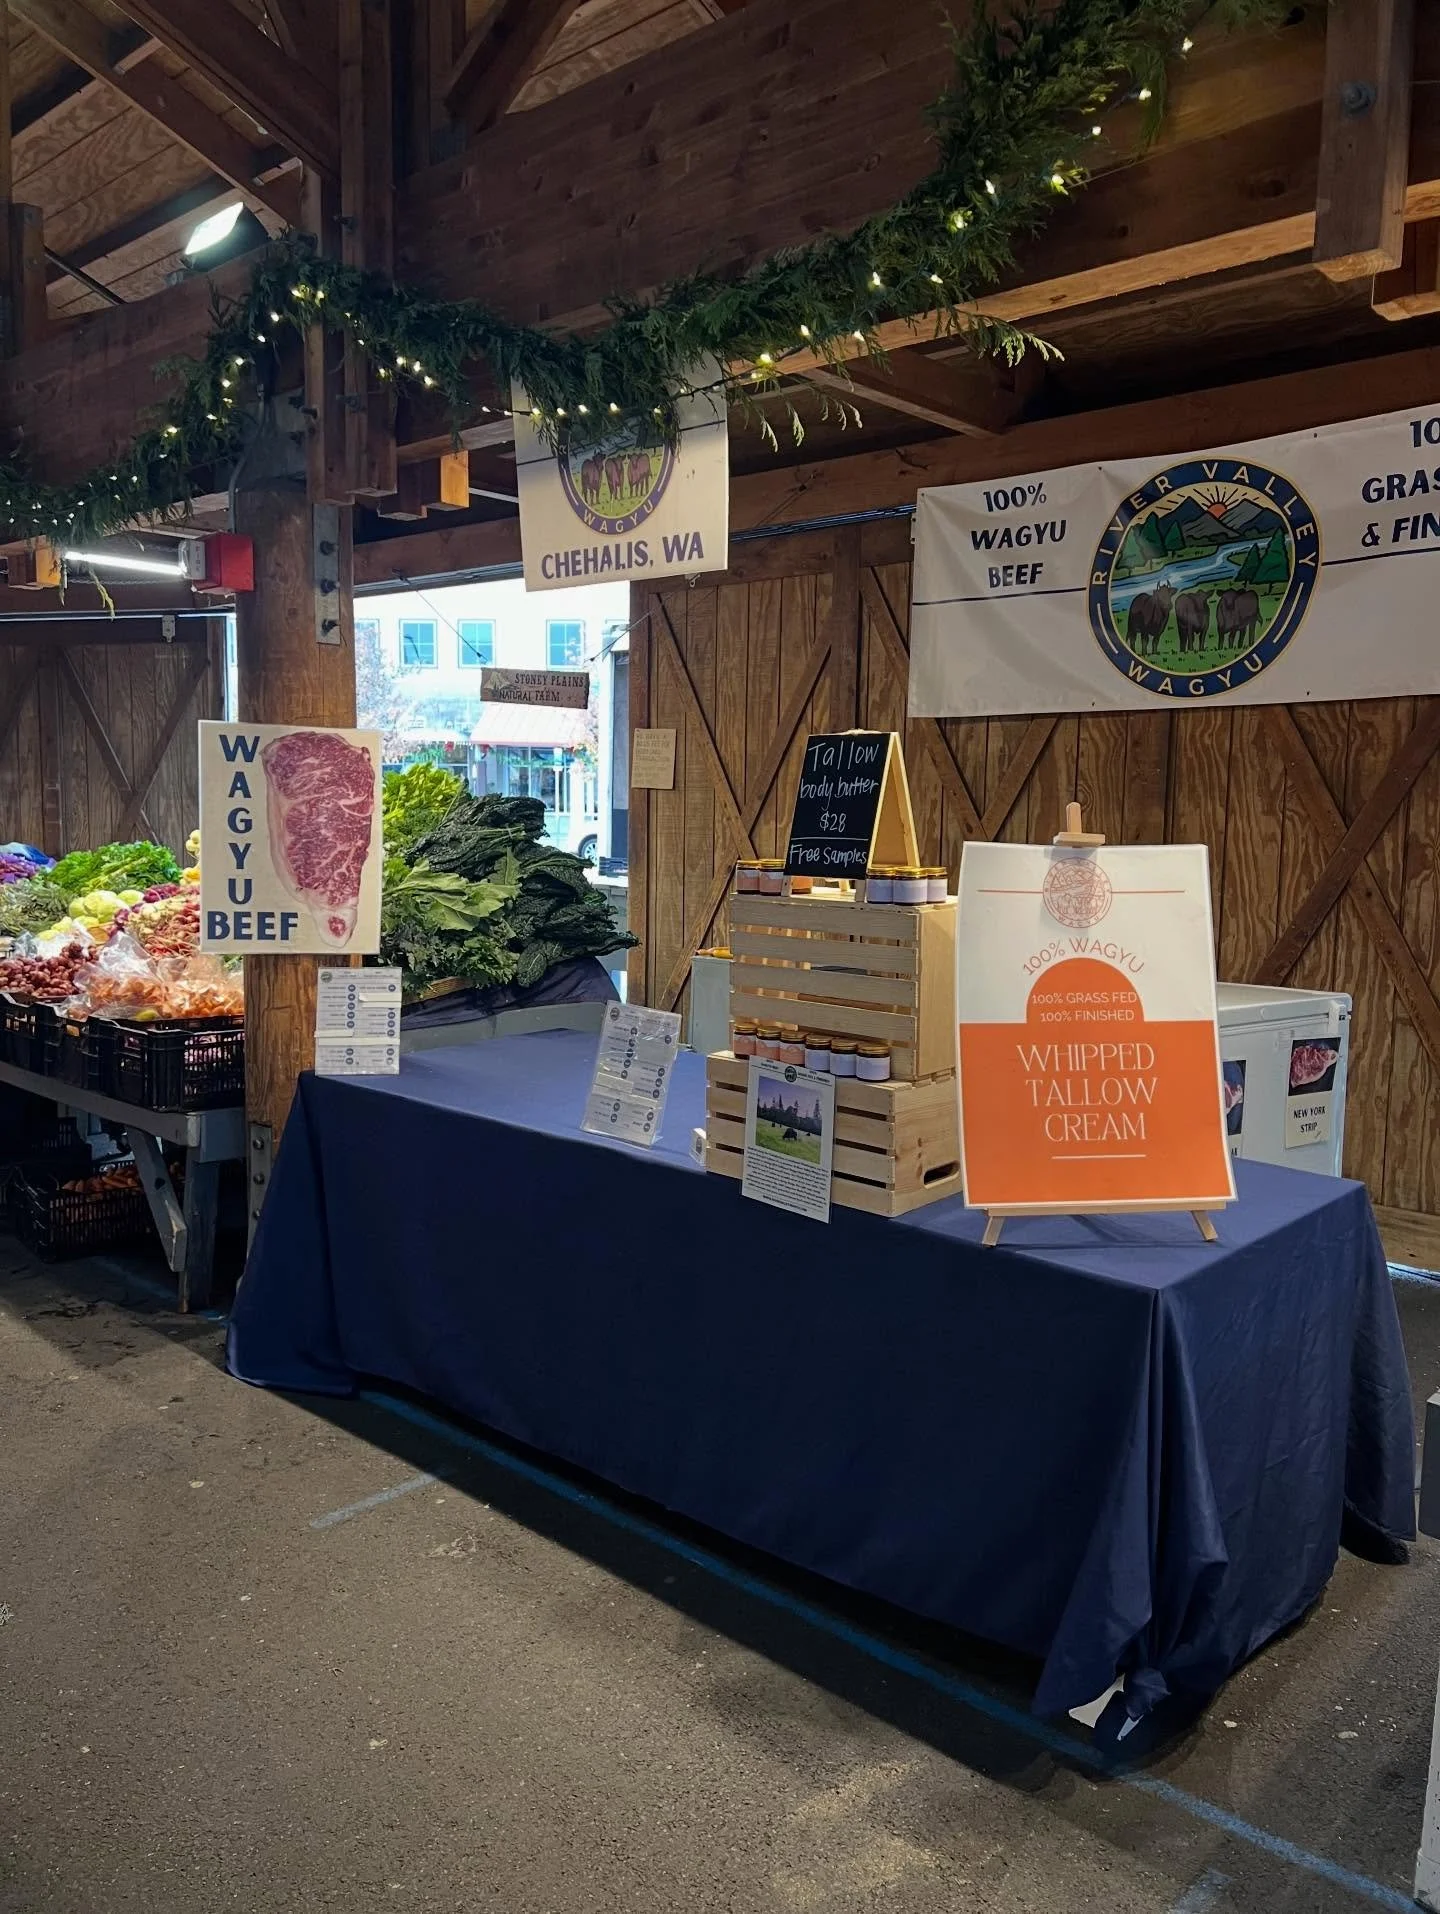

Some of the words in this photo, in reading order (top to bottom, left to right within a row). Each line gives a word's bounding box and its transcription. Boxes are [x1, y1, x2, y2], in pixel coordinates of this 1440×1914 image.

[983, 483, 1047, 513] 100%
[584, 502, 654, 533] WAGYU
[1092, 475, 1172, 586] RIVER
[1202, 462, 1317, 568] VALLEY
[971, 519, 1067, 551] WAGYU
[1361, 522, 1381, 547] &
[541, 540, 653, 580] CHEHALIS,
[662, 531, 704, 564] WA
[988, 563, 1043, 588] BEEF
[515, 672, 549, 685] STONEY
[551, 675, 584, 688] PLAINS
[1127, 653, 1264, 696] WAGYU
[808, 740, 879, 771] Tallow
[800, 775, 834, 811] body
[836, 776, 879, 798] butter
[219, 735, 260, 905] WAGYU
[819, 811, 847, 833] $28
[789, 844, 820, 865] Free
[206, 911, 299, 941] BEEF
[1023, 939, 1066, 977] 100%
[1069, 937, 1145, 974] WAGYU
[1032, 993, 1064, 1005] 100%
[1066, 992, 1109, 1004] GRASS
[1112, 991, 1138, 1004] FED
[1040, 1010, 1072, 1022] 100%
[1075, 1009, 1135, 1022] FINISHED
[1016, 1043, 1155, 1073] WHIPPED
[1025, 1077, 1158, 1107] TALLOW
[1045, 1112, 1148, 1142] CREAM
[1293, 1108, 1308, 1119] NEW
[1310, 1106, 1326, 1117] YORK
[1300, 1122, 1318, 1133] STRIP
